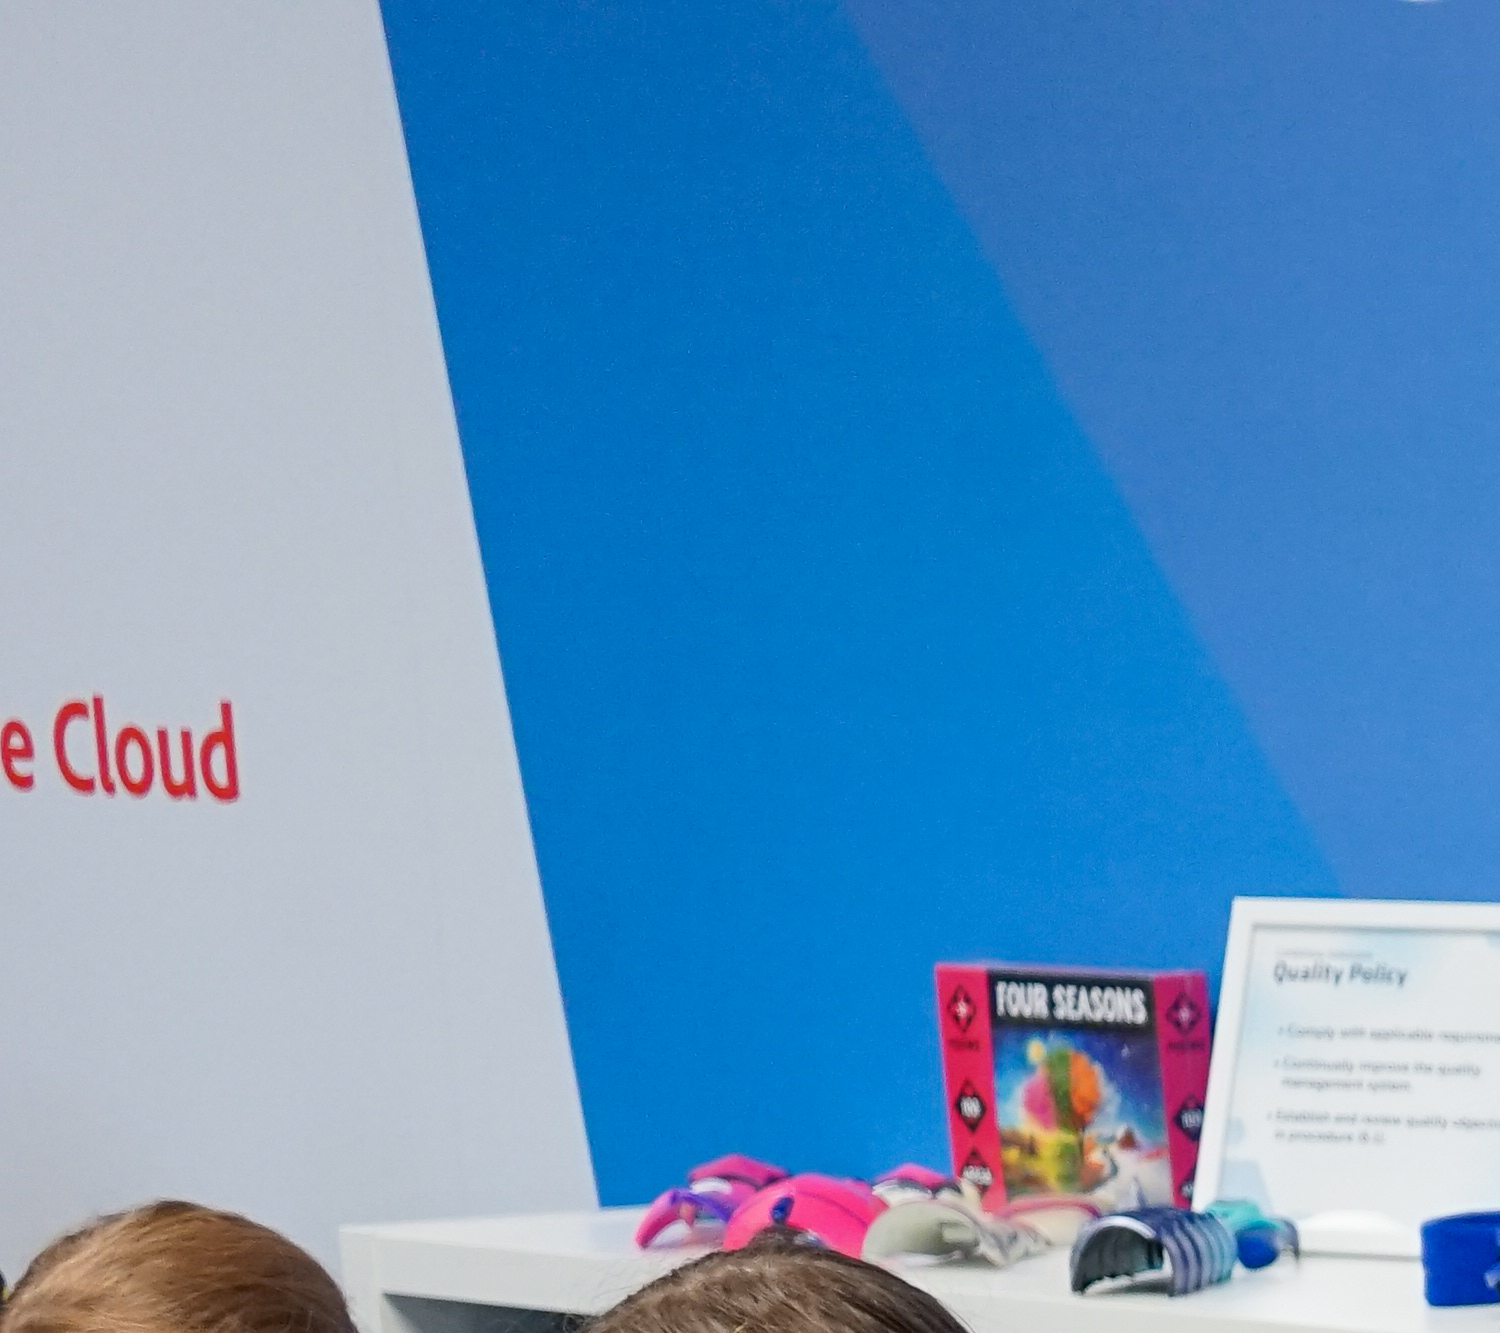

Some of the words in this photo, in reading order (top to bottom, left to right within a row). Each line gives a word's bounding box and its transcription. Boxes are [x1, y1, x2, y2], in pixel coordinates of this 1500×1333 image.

[54, 693, 241, 804] Cloud
[1274, 961, 1344, 987] Quality
[1349, 962, 1408, 988] Policy
[996, 980, 1049, 1018] FOUR
[1052, 984, 1148, 1024] SEASONS
